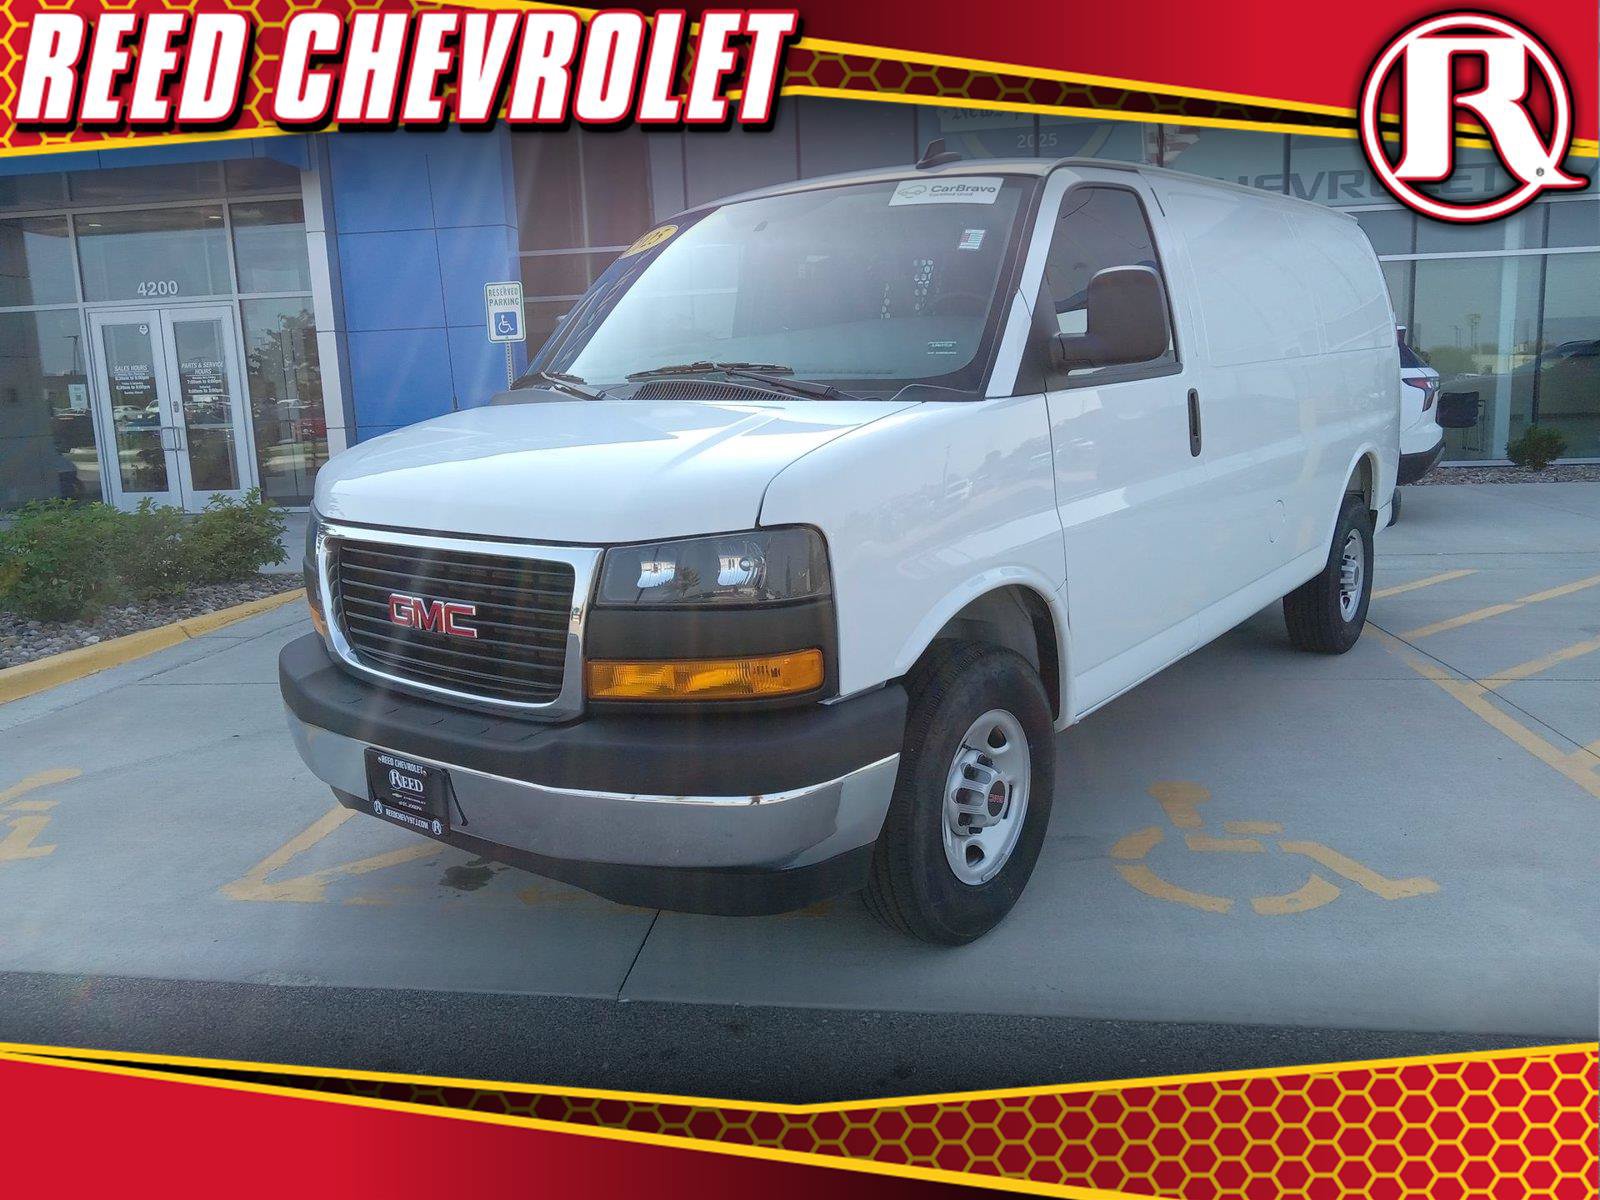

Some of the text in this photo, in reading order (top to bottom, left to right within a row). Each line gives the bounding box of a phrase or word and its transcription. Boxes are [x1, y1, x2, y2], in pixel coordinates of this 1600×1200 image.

[1016, 132, 1058, 149] 2025
[931, 184, 996, 193] CarBravo
[137, 280, 179, 297] 4200
[488, 287, 520, 297] RESERVED
[489, 297, 520, 307] PARKING
[389, 593, 478, 638] GMC
[381, 755, 424, 774] REED CHEVROLET
[389, 769, 424, 792] REED
